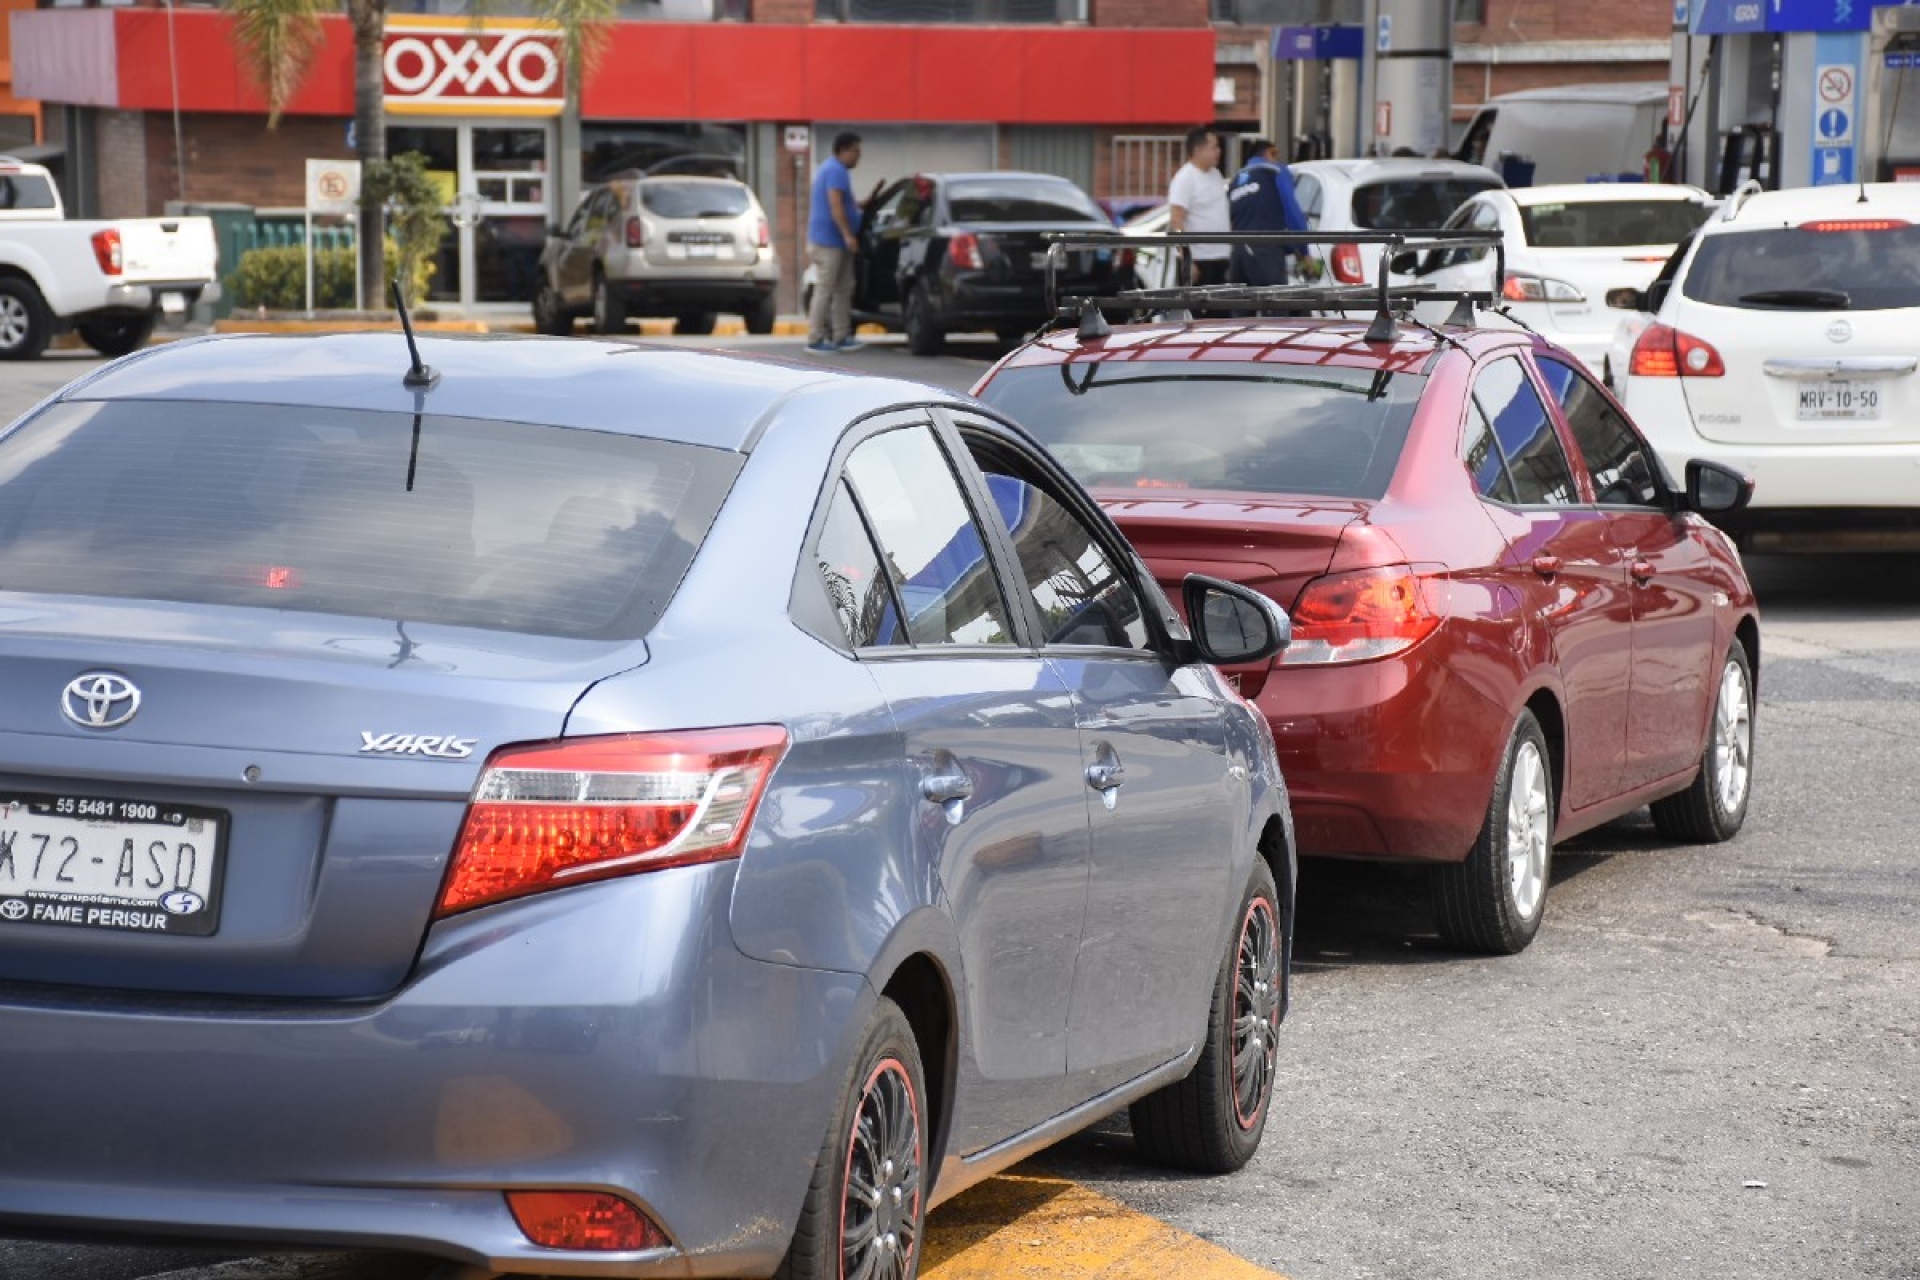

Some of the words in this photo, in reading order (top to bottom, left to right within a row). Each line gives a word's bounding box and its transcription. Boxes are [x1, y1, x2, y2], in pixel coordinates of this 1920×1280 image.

[384, 37, 558, 95] OXXO
[1799, 391, 1878, 409] MRV-10-50
[359, 730, 479, 758] YARIS
[56, 798, 75, 812] 55
[78, 800, 114, 816] 5481
[119, 804, 157, 819] 1900
[32, 903, 83, 923] FAME
[87, 909, 167, 929] PERISUR
